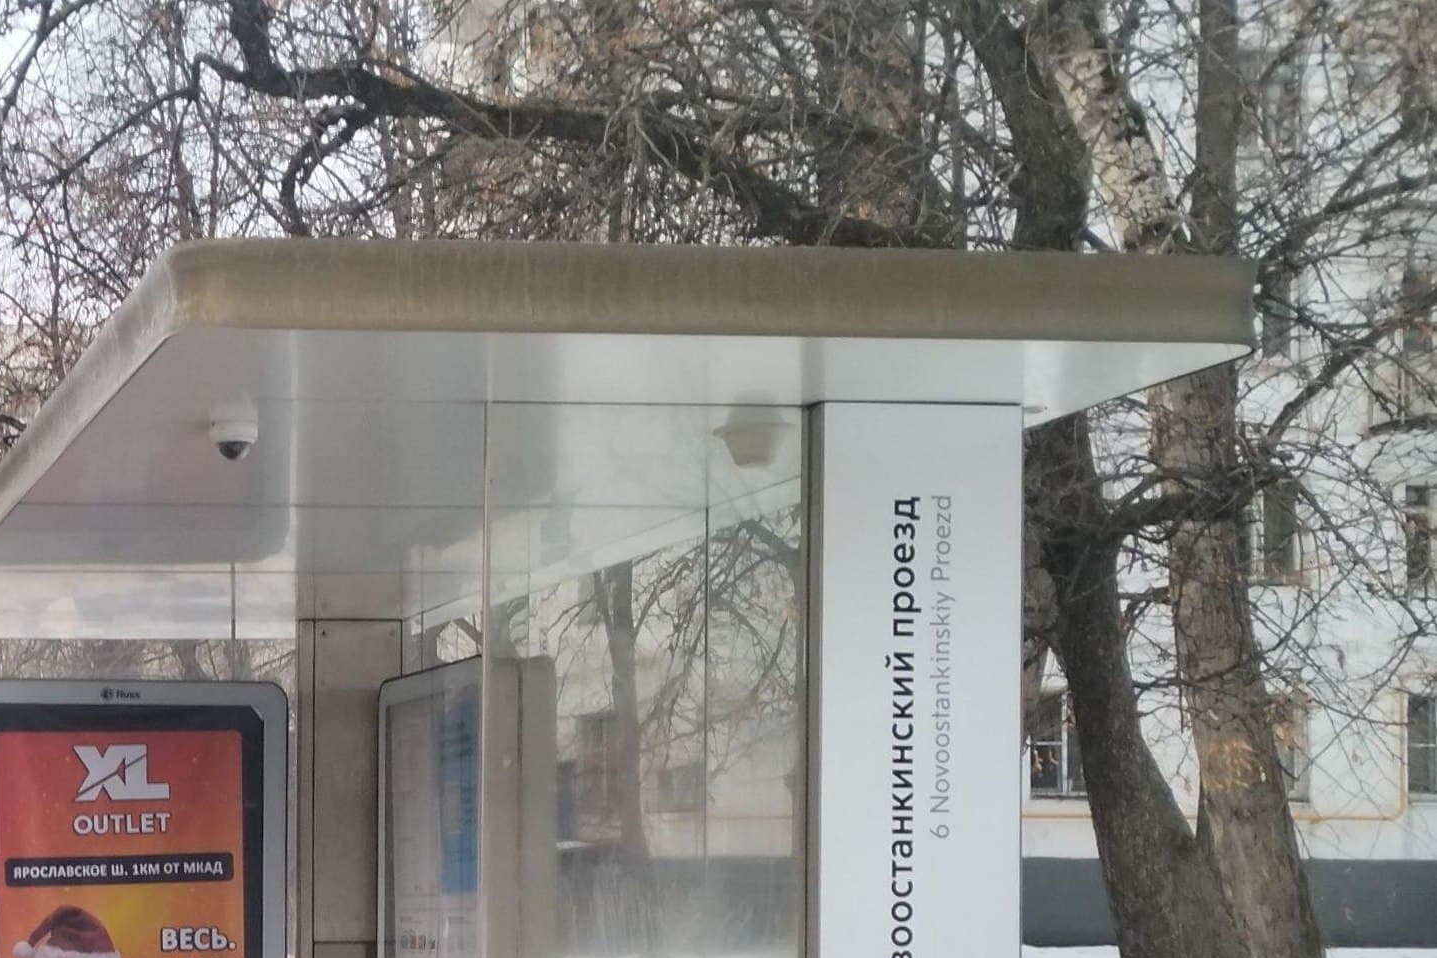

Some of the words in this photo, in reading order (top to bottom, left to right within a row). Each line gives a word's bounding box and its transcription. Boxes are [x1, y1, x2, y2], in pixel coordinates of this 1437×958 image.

[930, 494, 952, 581] Proezd
[892, 496, 922, 637] проезд
[929, 591, 956, 814] Novoostankinskiy
[72, 744, 171, 802] XL
[73, 812, 171, 835] OUTLET
[929, 824, 951, 839] 6
[13, 863, 108, 880] ЯРОСЛАВСКОЕ
[111, 864, 129, 877] Ш.
[132, 863, 161, 876] 1КМ
[163, 861, 180, 875] ОТ
[183, 860, 224, 875] МКАД
[161, 927, 237, 951] ВЕСЬ.
